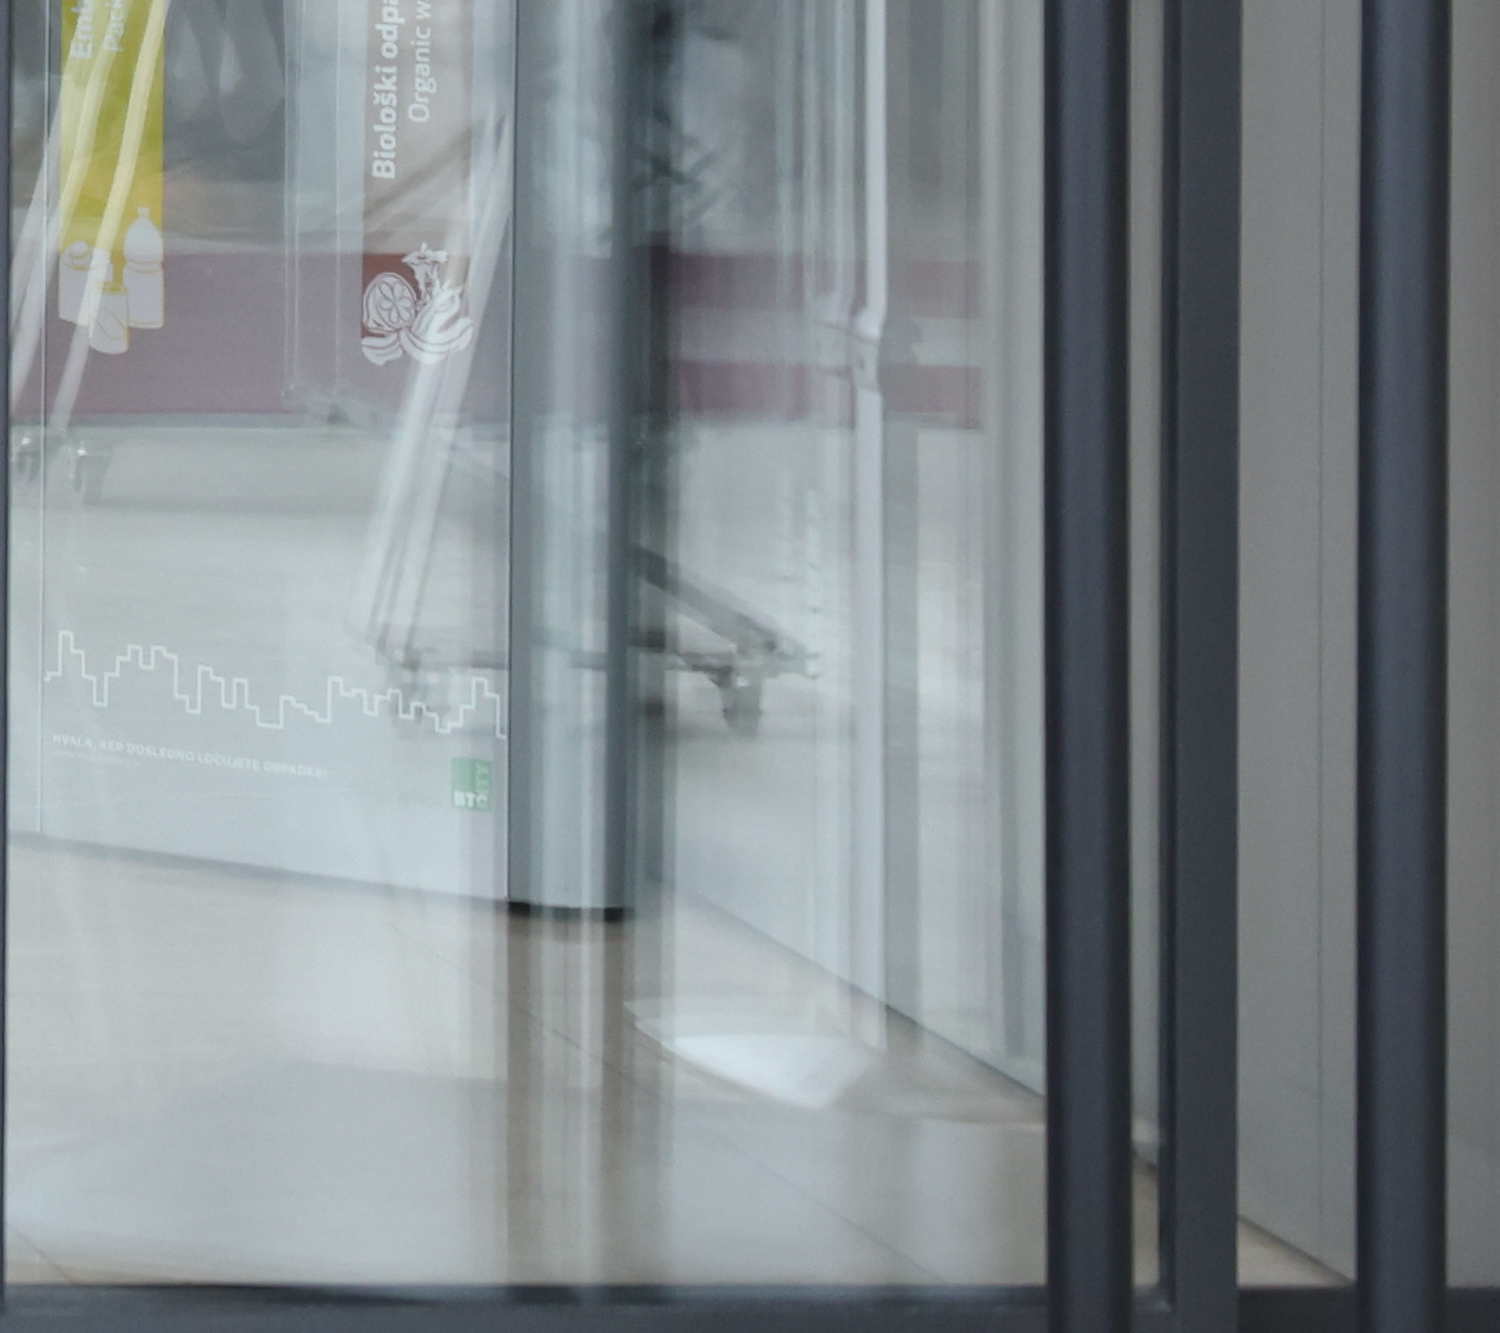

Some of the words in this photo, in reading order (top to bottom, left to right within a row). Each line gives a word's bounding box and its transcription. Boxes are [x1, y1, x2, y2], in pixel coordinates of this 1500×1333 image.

[408, 26, 437, 123] Organic
[371, 64, 398, 180] Biološki
[125, 739, 196, 763] DOSLEDNO
[452, 790, 490, 810] BTC
